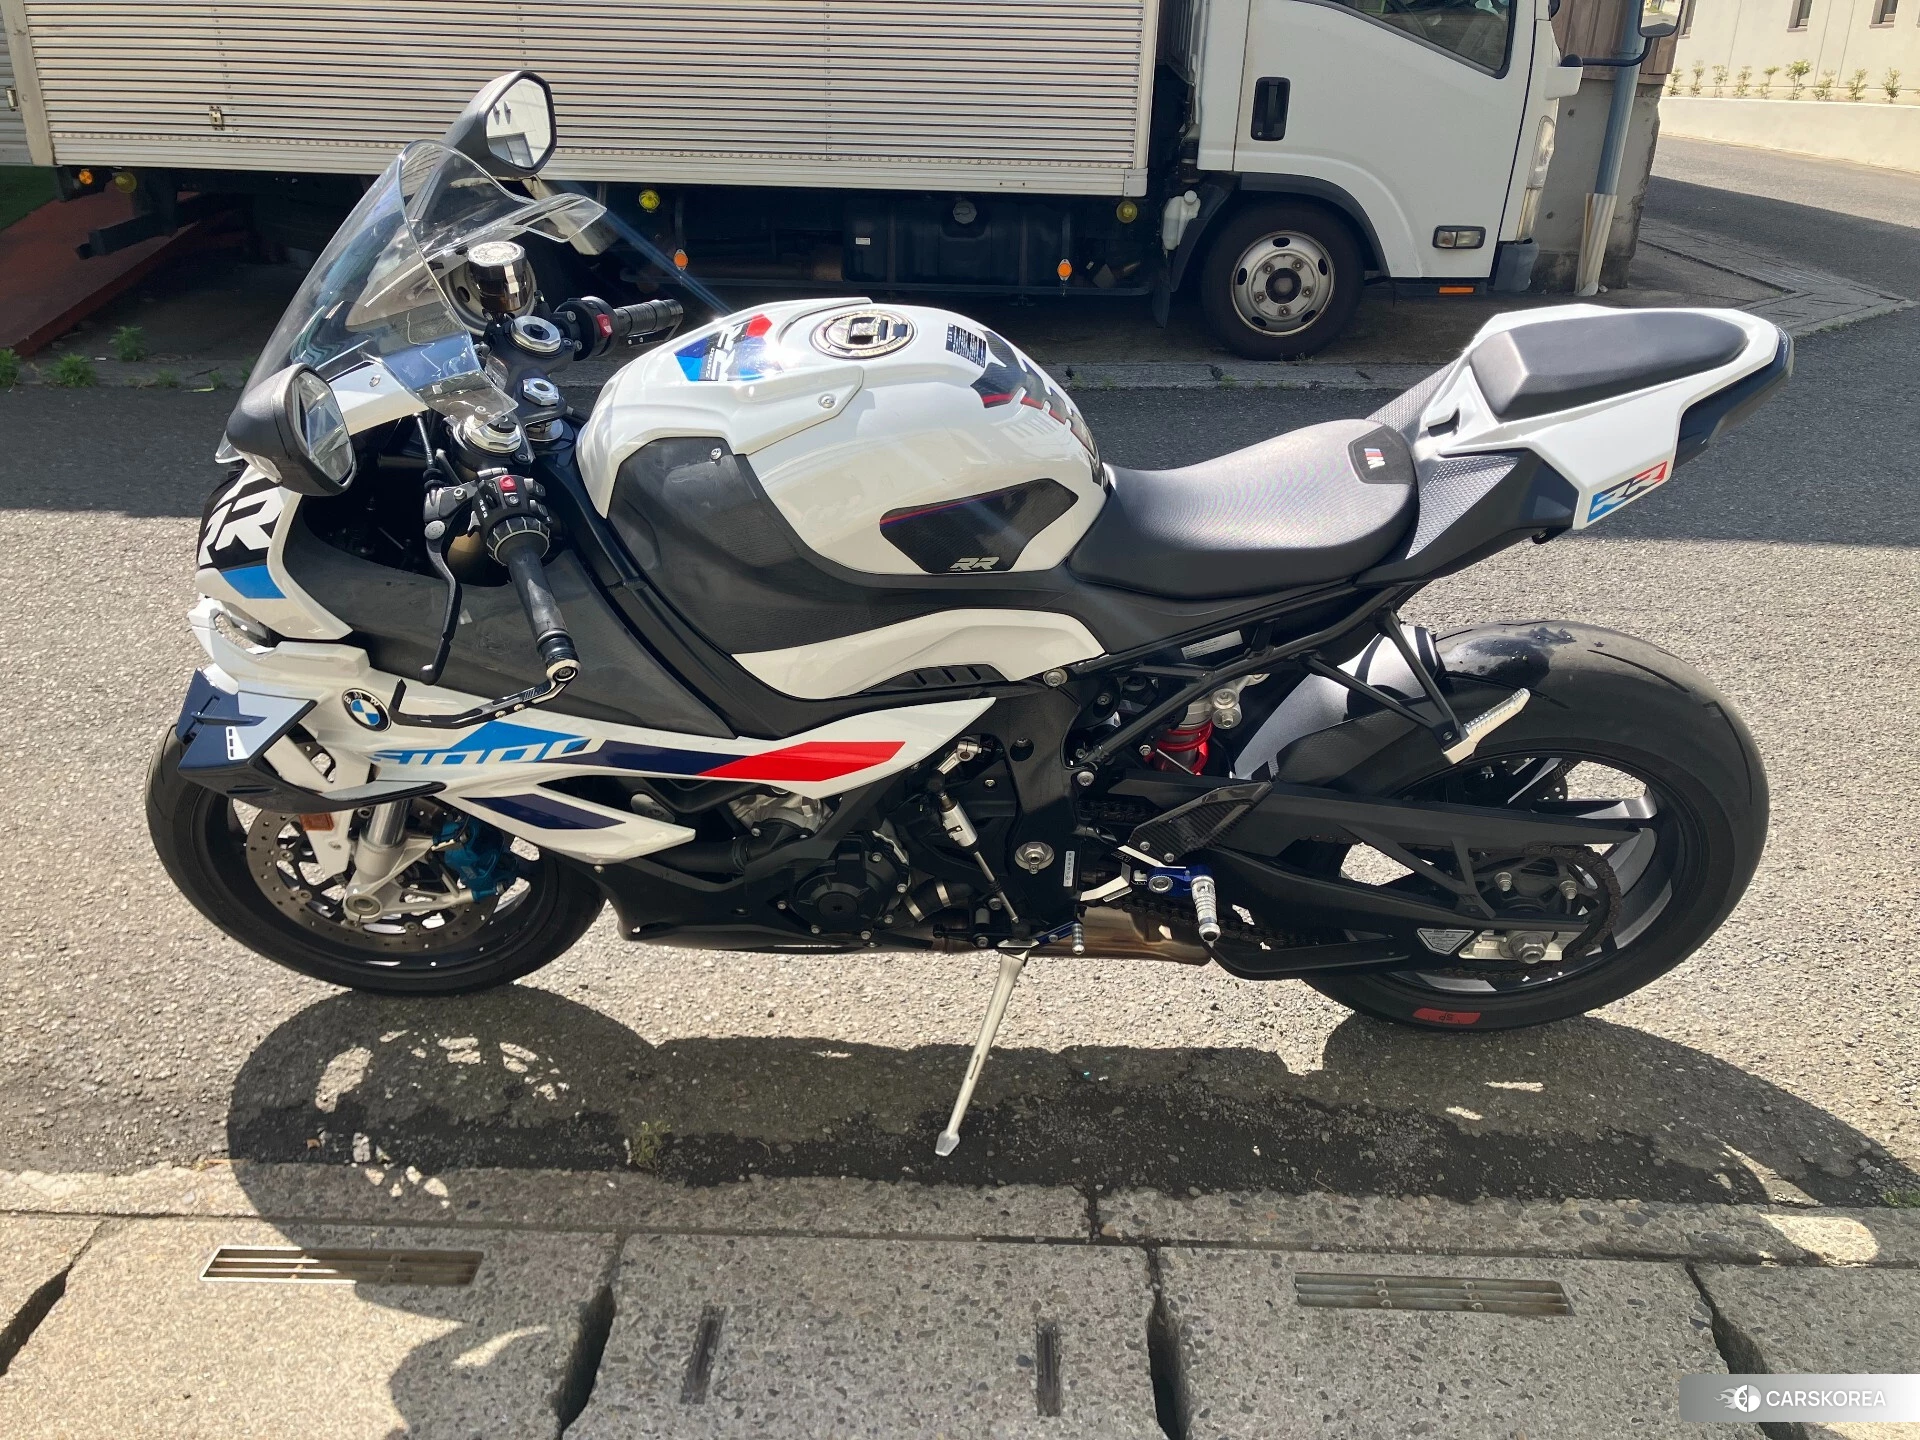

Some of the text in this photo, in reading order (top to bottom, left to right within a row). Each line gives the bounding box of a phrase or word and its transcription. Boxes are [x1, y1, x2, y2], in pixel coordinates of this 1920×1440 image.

[1590, 463, 1666, 514] RR
[949, 556, 1000, 571] RR
[343, 691, 380, 706] BMW
